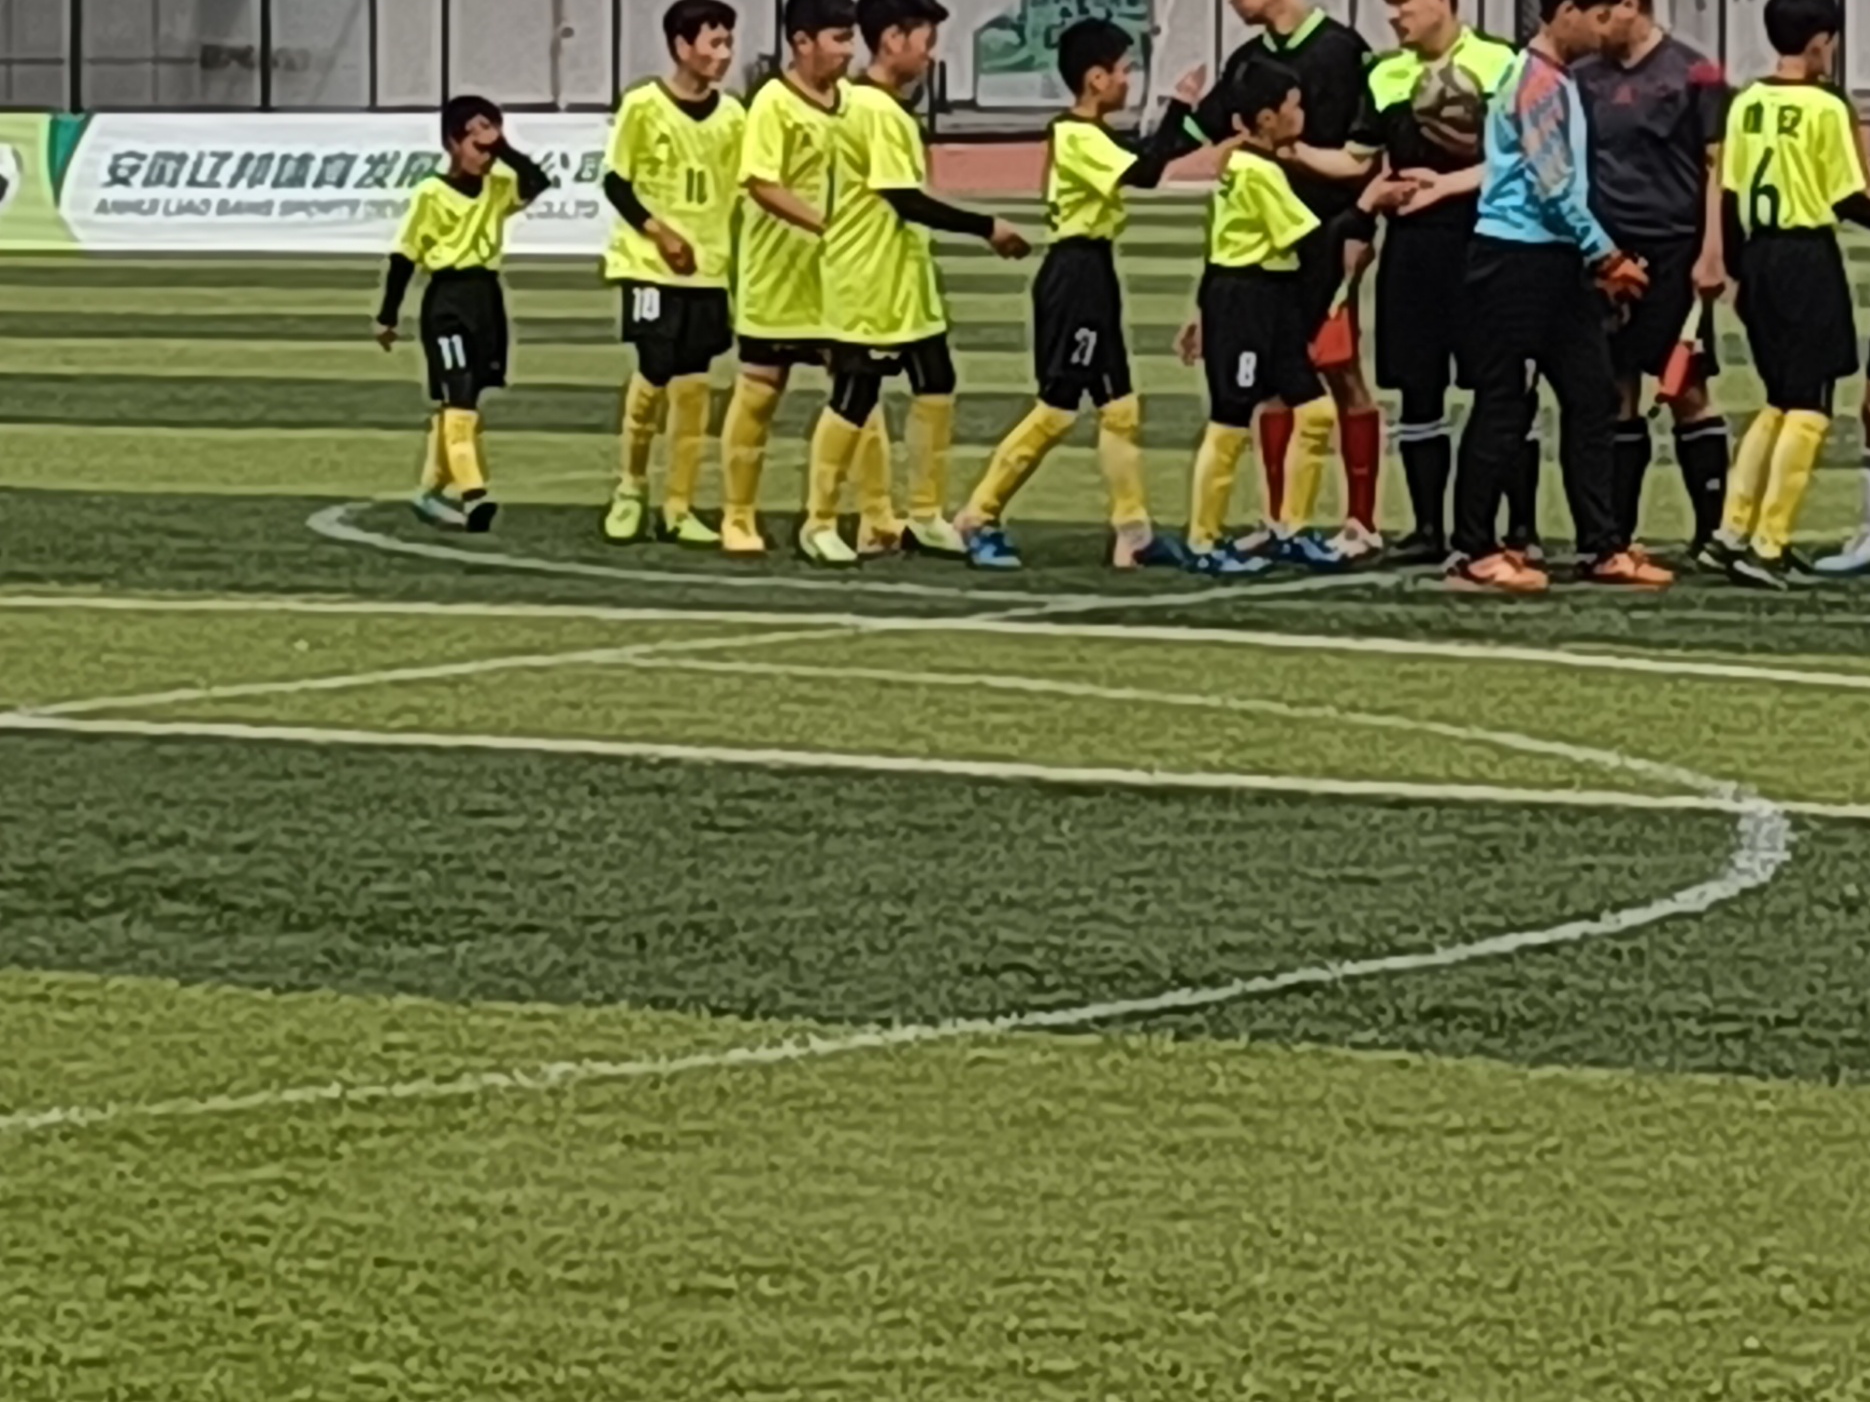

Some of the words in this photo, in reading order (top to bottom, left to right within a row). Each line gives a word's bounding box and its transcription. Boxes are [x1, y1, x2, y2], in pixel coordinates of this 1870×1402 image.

[1751, 146, 1780, 227] 6
[632, 287, 661, 322] 10
[438, 334, 466, 370] 11
